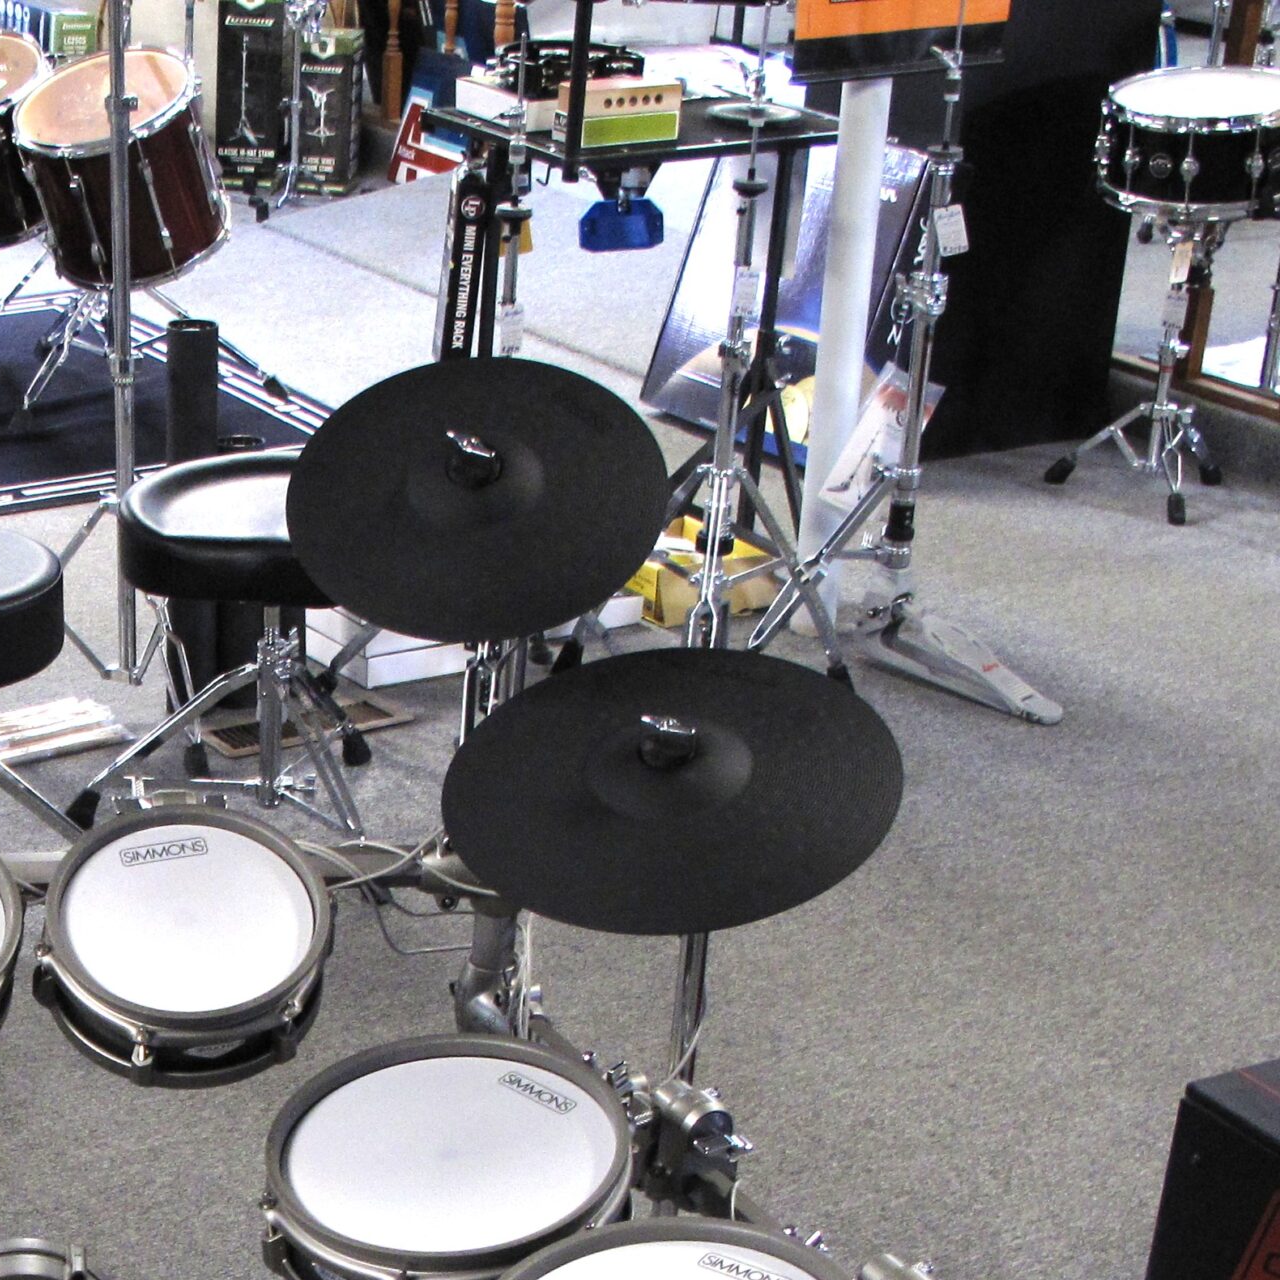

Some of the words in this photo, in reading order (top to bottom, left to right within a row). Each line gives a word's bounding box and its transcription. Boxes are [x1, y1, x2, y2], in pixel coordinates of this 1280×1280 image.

[463, 225, 477, 251] MINI
[455, 253, 474, 318] EVERYTHING
[451, 320, 466, 349] RACK
[123, 840, 204, 864] SIMMONS
[503, 1073, 572, 1112] SIMMONS
